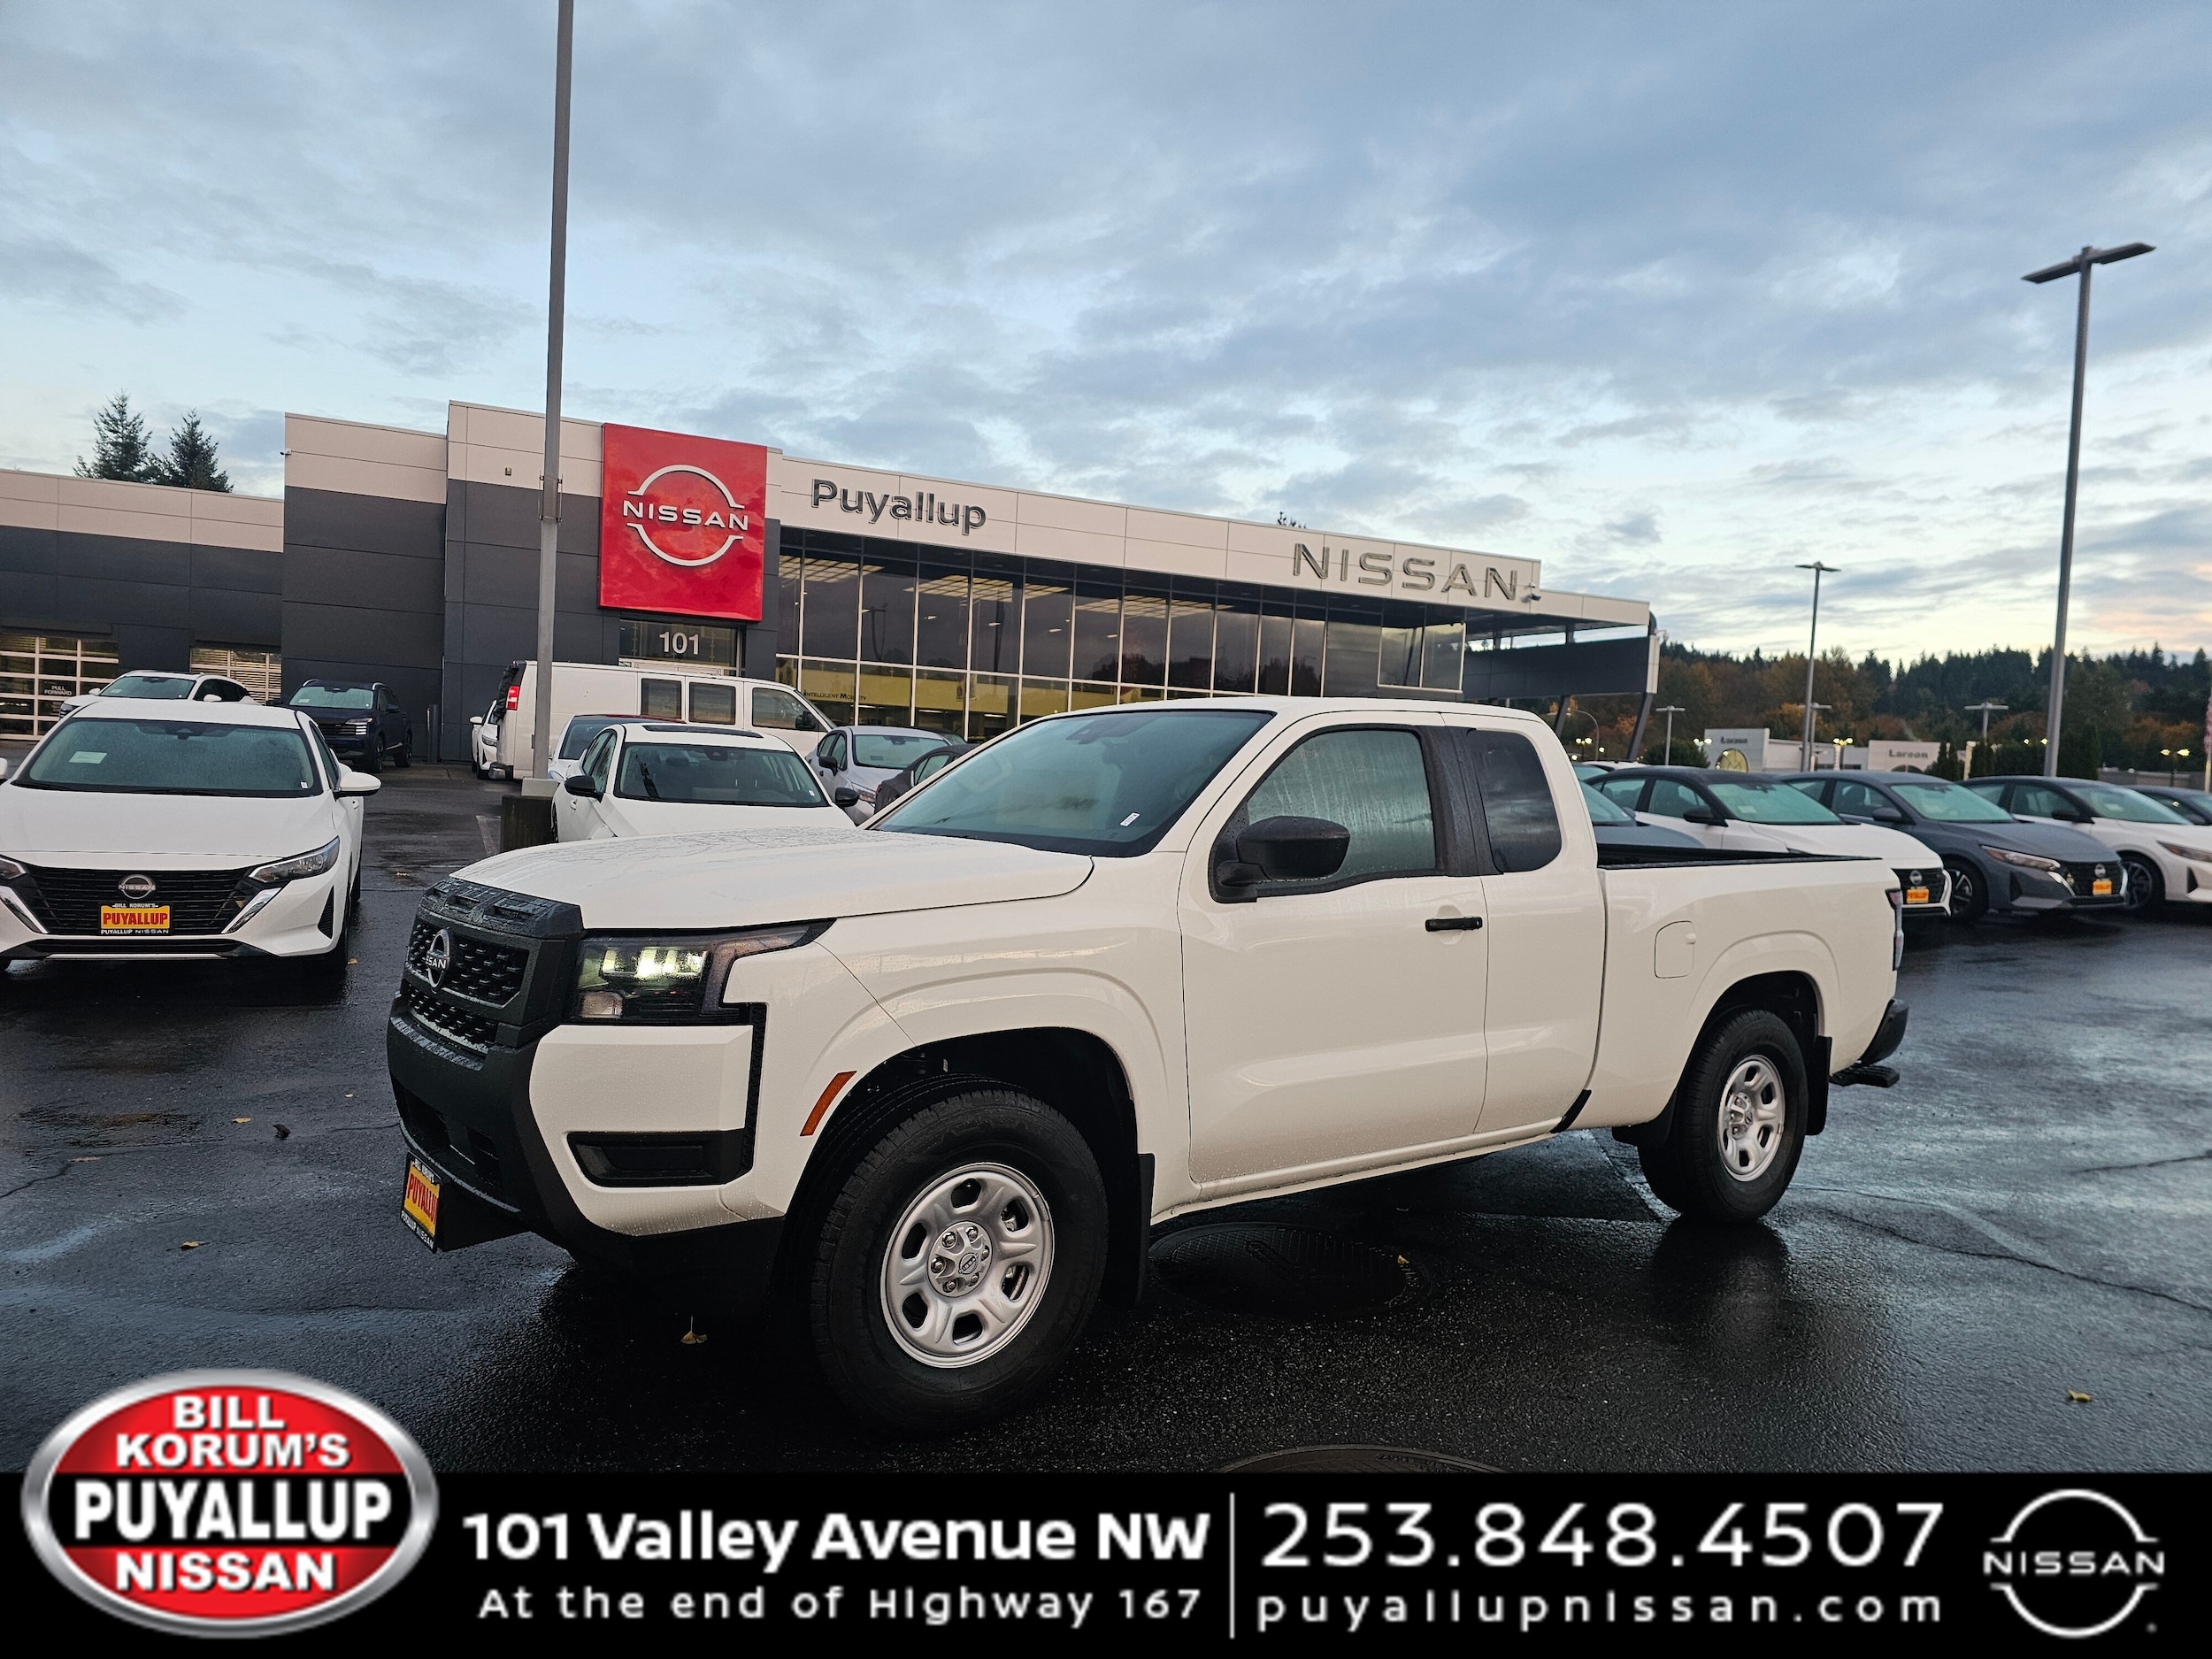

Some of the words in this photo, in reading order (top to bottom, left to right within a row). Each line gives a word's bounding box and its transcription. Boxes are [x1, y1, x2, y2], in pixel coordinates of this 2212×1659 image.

[622, 499, 749, 532] NISSAN
[810, 478, 987, 536] Puyallup
[1293, 542, 1518, 601] NISSAN
[658, 631, 700, 656] 101
[103, 912, 168, 926] PUYALLUP
